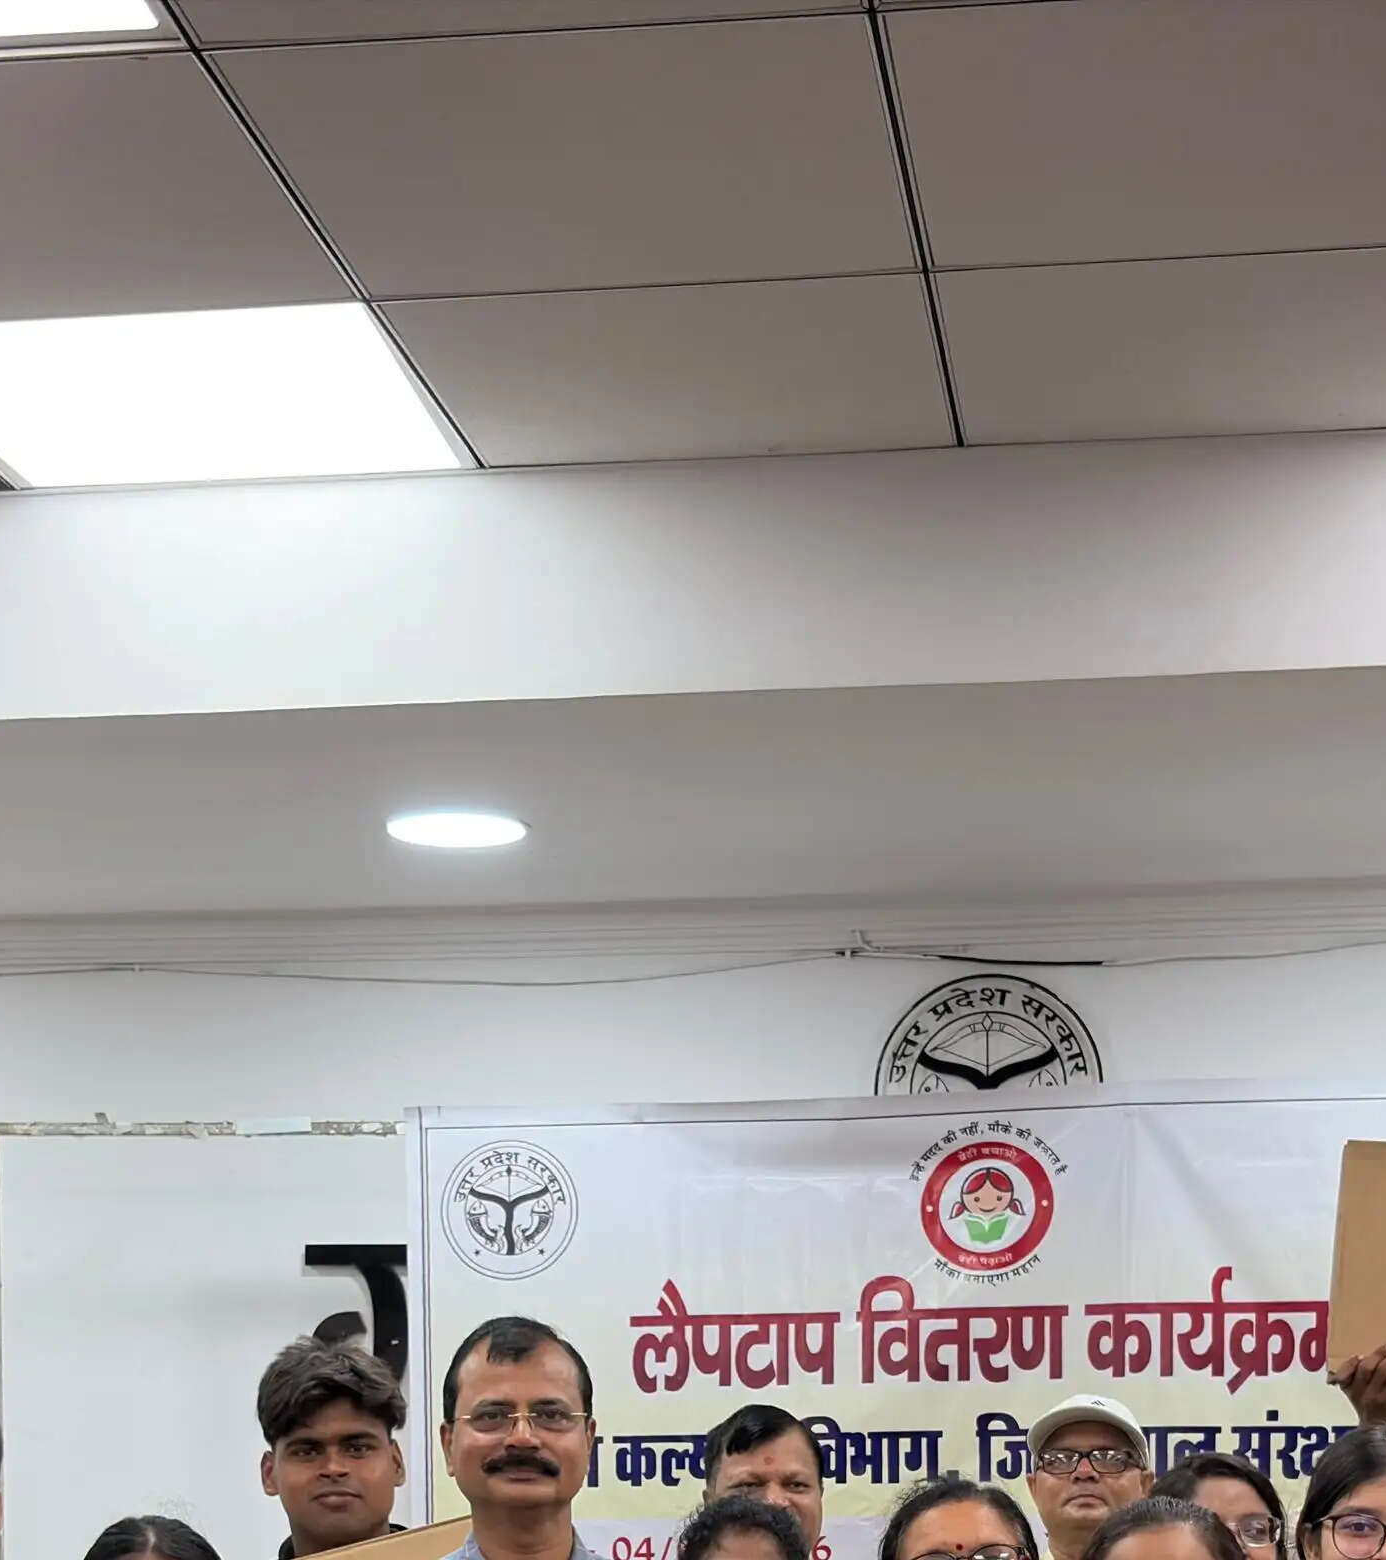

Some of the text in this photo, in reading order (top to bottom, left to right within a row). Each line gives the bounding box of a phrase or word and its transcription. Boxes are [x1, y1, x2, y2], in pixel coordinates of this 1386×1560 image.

[889, 988, 1089, 1083] उत्तर प्रदेश सरकार
[920, 1142, 943, 1163] मदद
[941, 1130, 958, 1146] की
[1015, 1126, 1033, 1141] की
[453, 1150, 567, 1205] उत्तर प्रदेश सरकार
[1012, 1254, 1042, 1278] महान
[629, 1278, 840, 1393] लैपटाप
[857, 1275, 1069, 1386] वितरण
